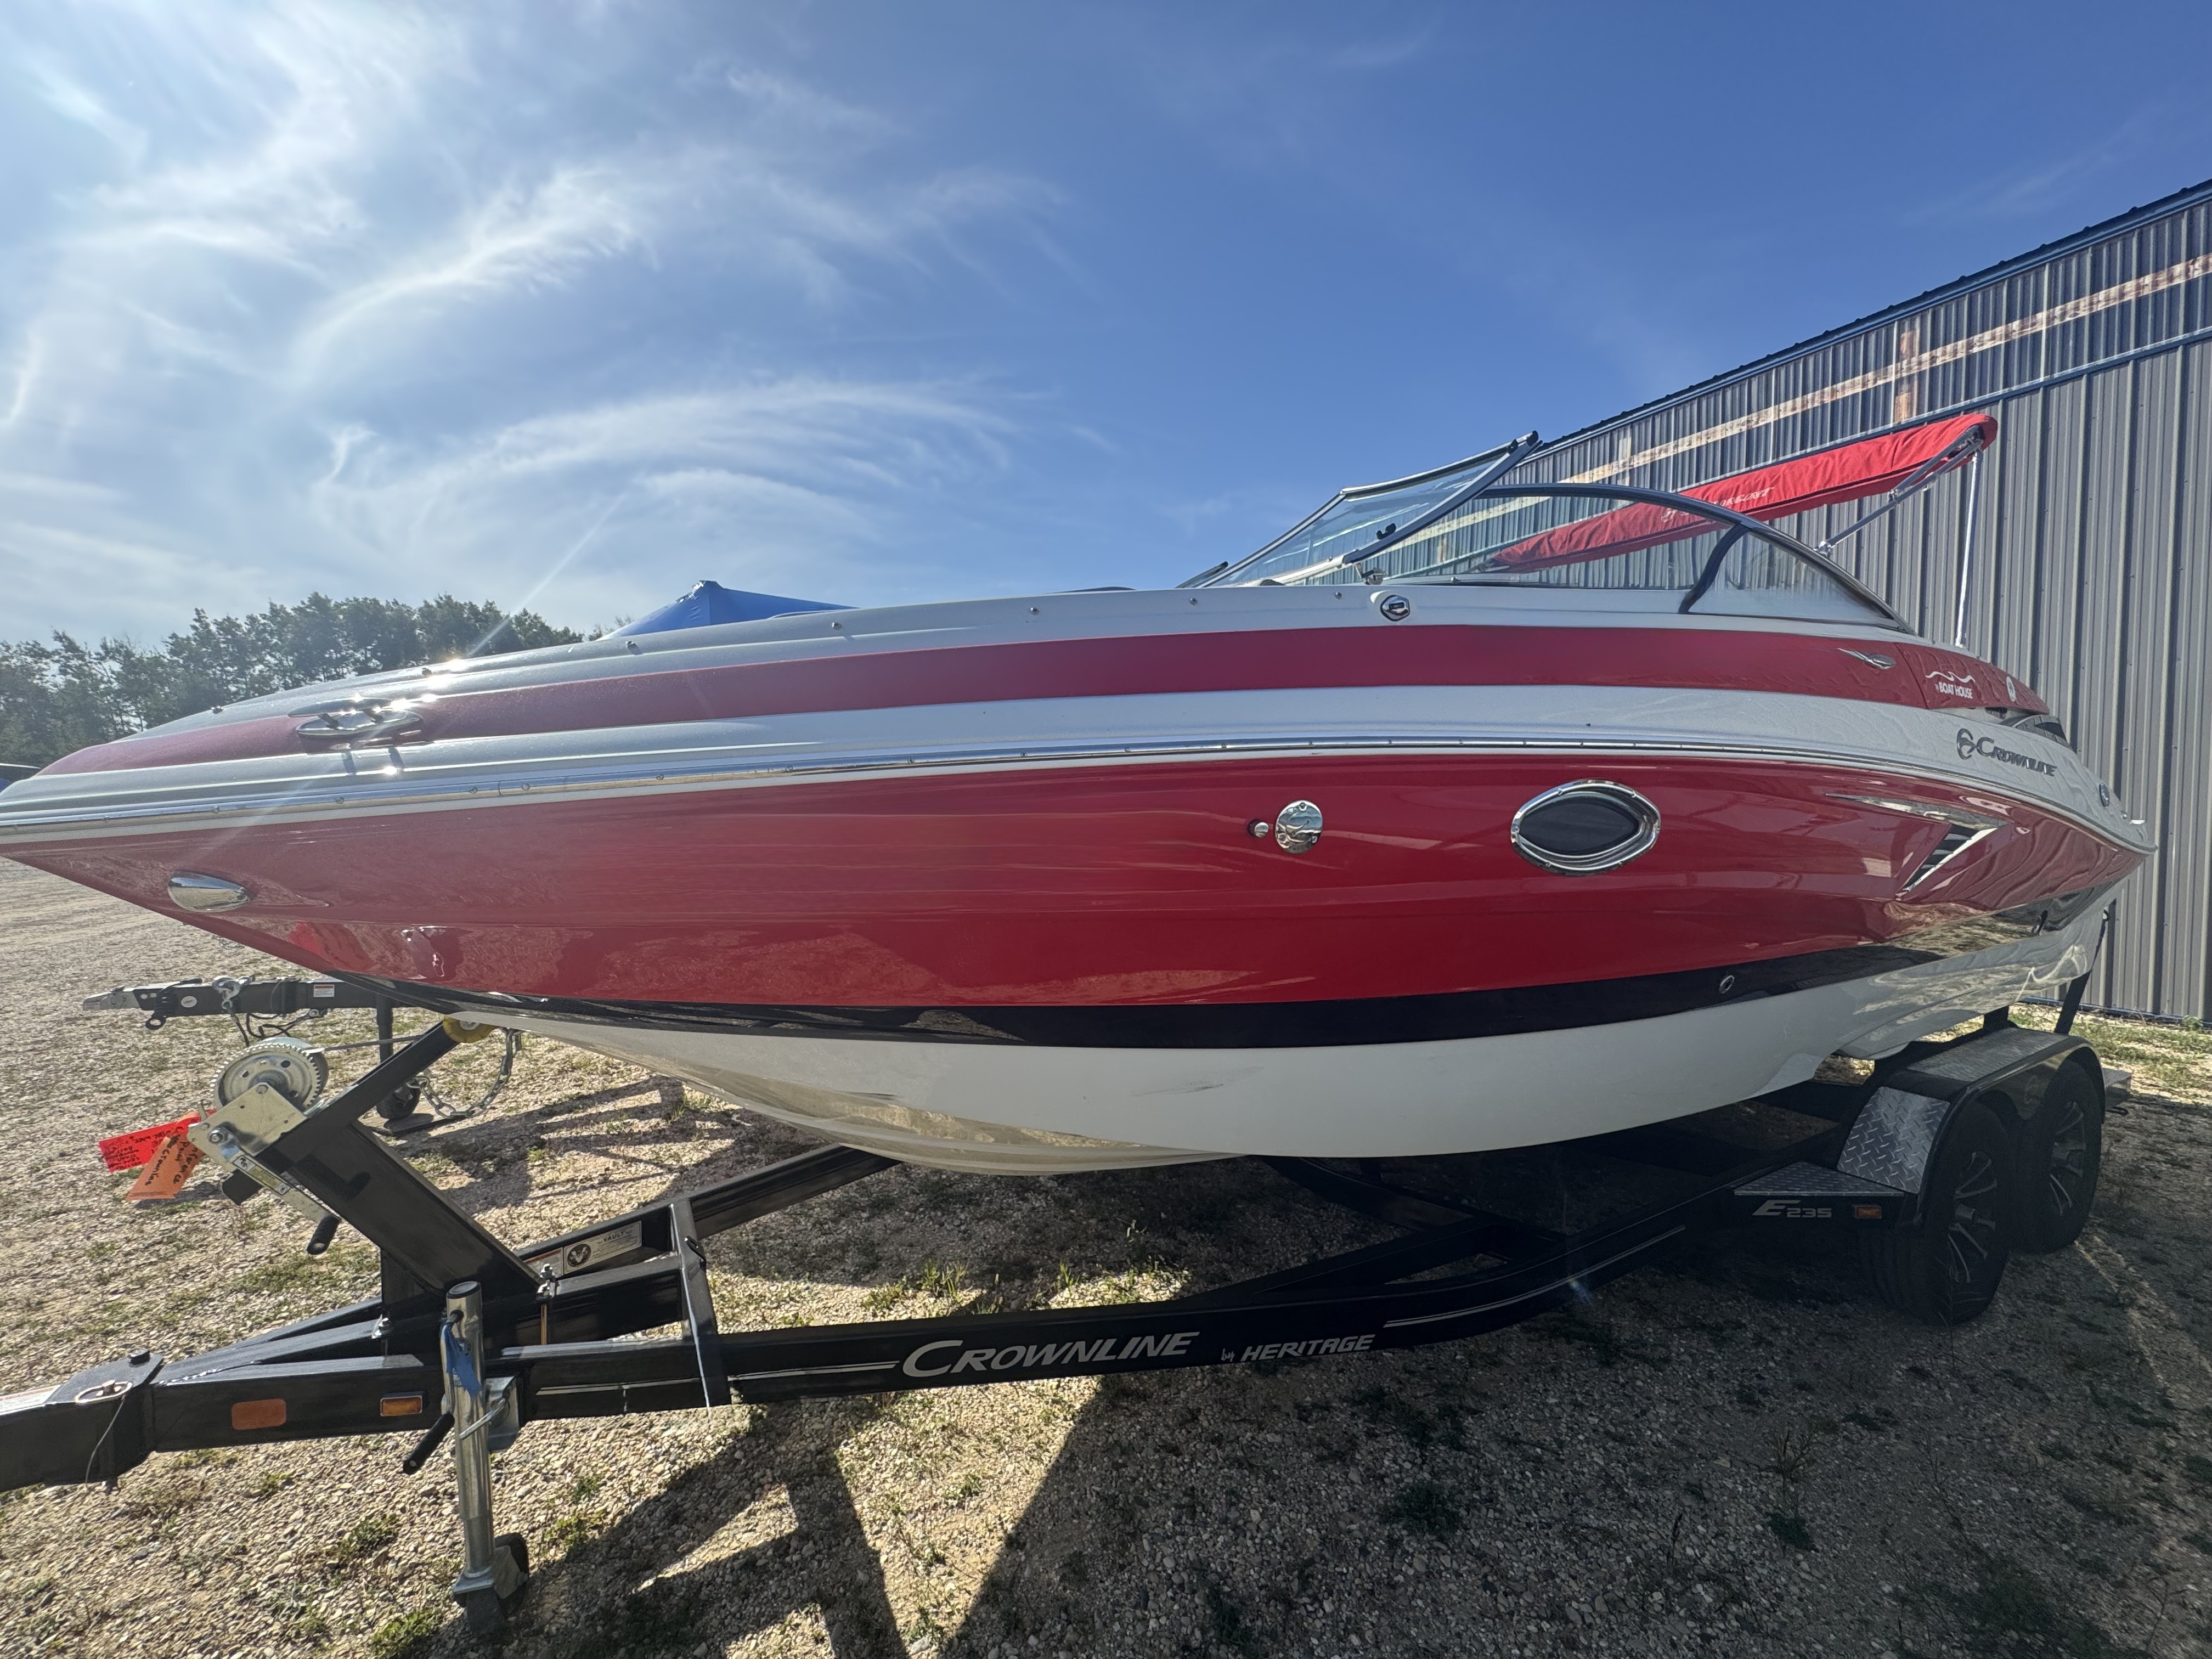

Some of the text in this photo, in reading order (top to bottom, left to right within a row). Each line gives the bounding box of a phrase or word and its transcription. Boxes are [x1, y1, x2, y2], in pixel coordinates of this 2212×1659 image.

[1938, 681, 1954, 695] BOAT
[1954, 685, 1973, 699] HOUSE
[1977, 737, 2057, 776] CROWNLINE
[603, 1231, 624, 1242] VAULT
[902, 1331, 1376, 1378] CROWNLINE by HERITAGE
